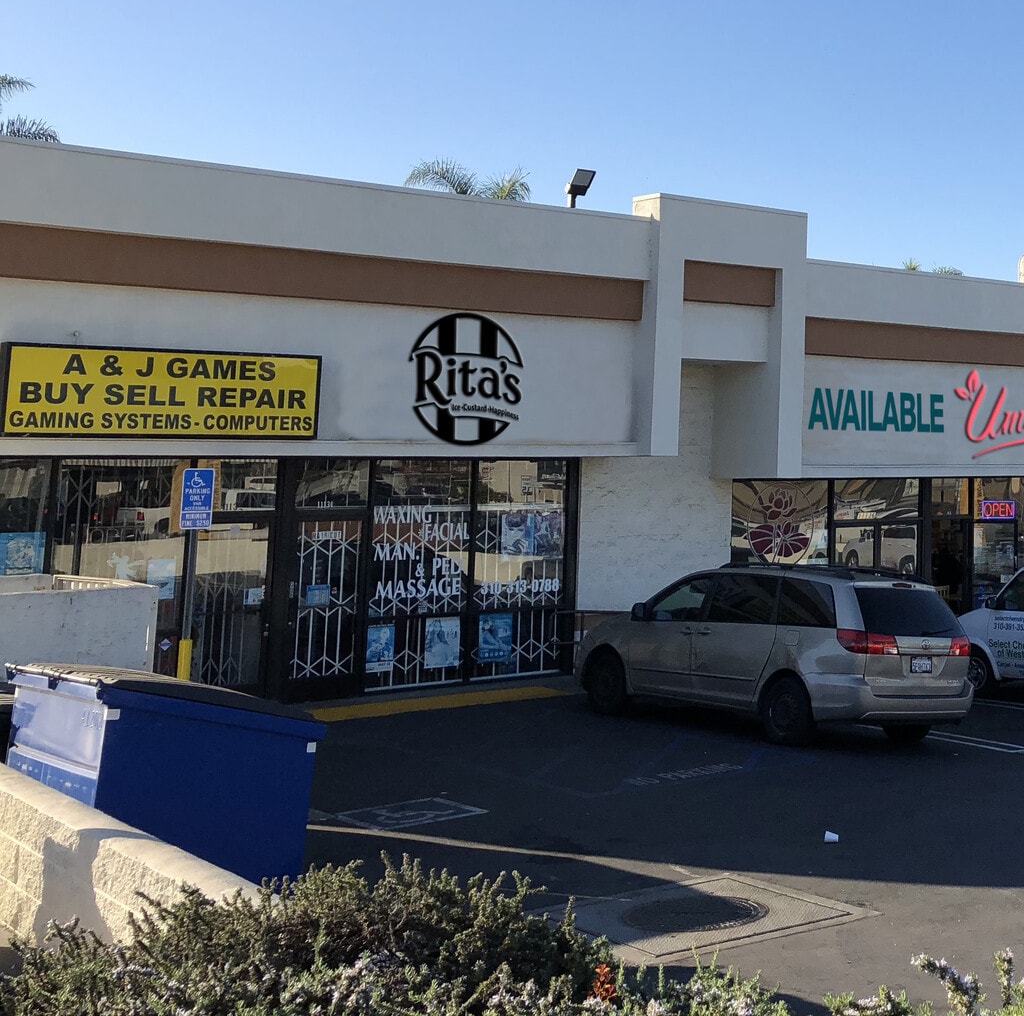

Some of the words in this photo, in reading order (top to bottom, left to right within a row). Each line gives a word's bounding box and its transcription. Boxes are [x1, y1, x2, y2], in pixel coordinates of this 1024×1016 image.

[62, 353, 87, 375] A
[100, 354, 124, 376] &
[136, 356, 155, 378] J
[166, 357, 276, 382] GAMES
[415, 350, 522, 406] Rita's
[19, 382, 95, 405] BUY
[103, 383, 186, 407] SELL
[197, 386, 307, 410] REPAIR
[8, 410, 94, 429] GAMING
[808, 387, 945, 433] AVAILABLE
[373, 505, 432, 525] WAXING
[983, 502, 1014, 517] OPEN
[424, 522, 470, 542] FACIAL
[373, 543, 420, 562] MAN.
[415, 562, 425, 578] &
[375, 577, 461, 600] MASSAGE
[988, 638, 1012, 649] Select
[997, 649, 1005, 658] of
[1006, 649, 1024, 659] West
